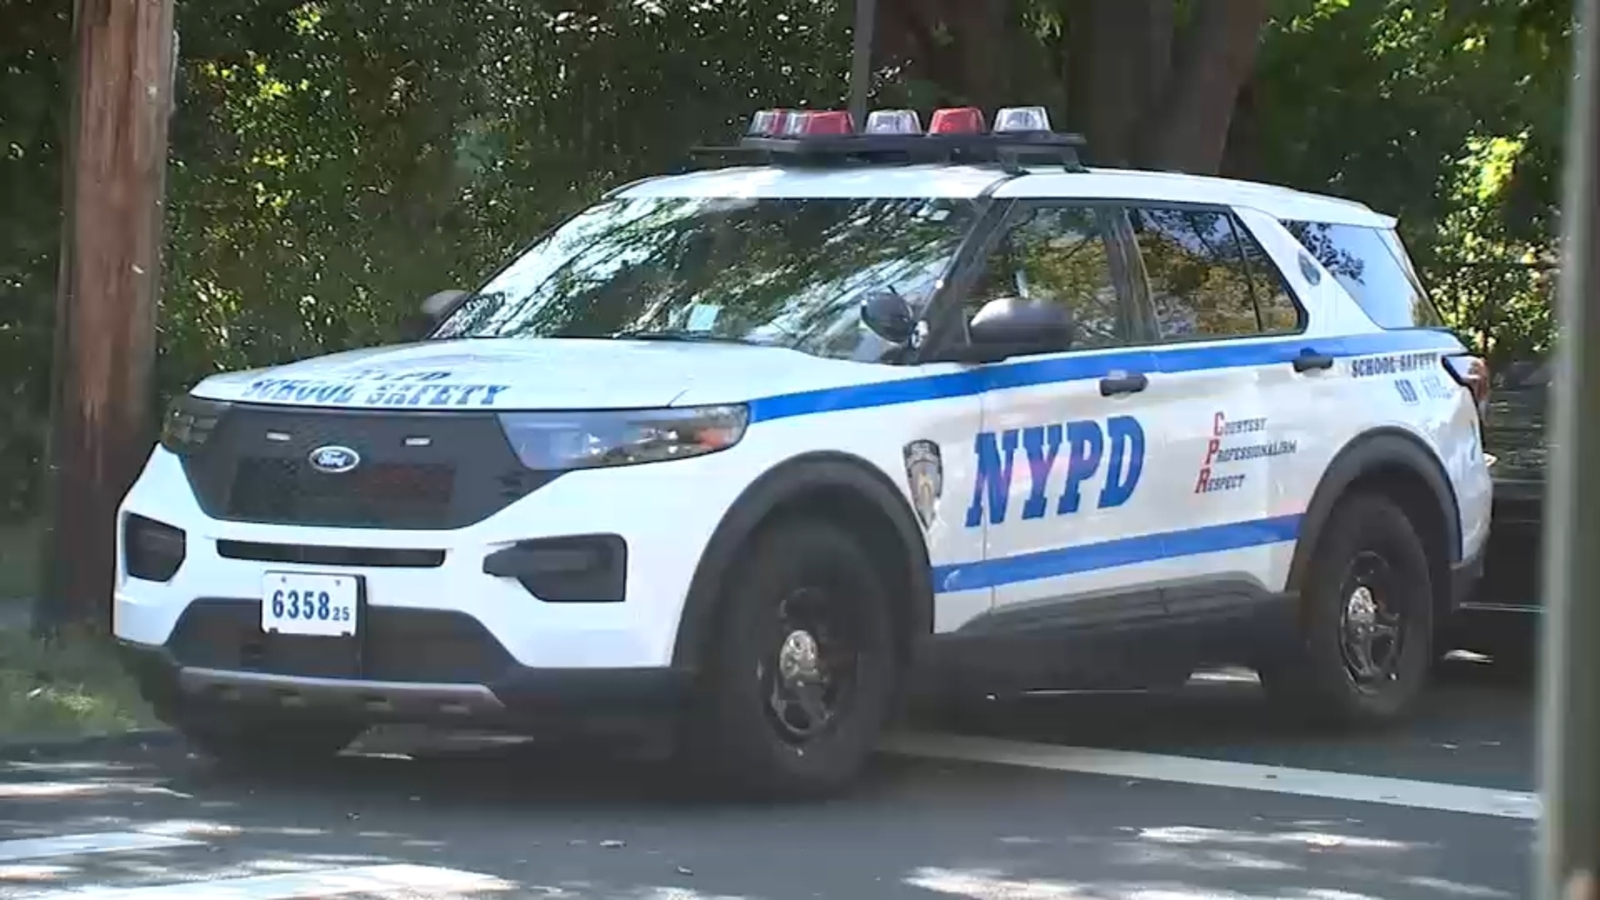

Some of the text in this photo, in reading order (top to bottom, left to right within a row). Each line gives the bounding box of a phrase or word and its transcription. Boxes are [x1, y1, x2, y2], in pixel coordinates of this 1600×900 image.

[1351, 353, 1438, 378] SCHOOL SAFETY
[241, 379, 511, 405] SCHOOL SAFETY
[1214, 411, 1268, 436] COURTESY
[317, 449, 349, 467] Ford
[1205, 439, 1298, 465] PROFESSIONALISM
[964, 415, 1146, 528] NYPD
[1194, 467, 1246, 493] RESPECT
[272, 589, 350, 621] 6358 25
